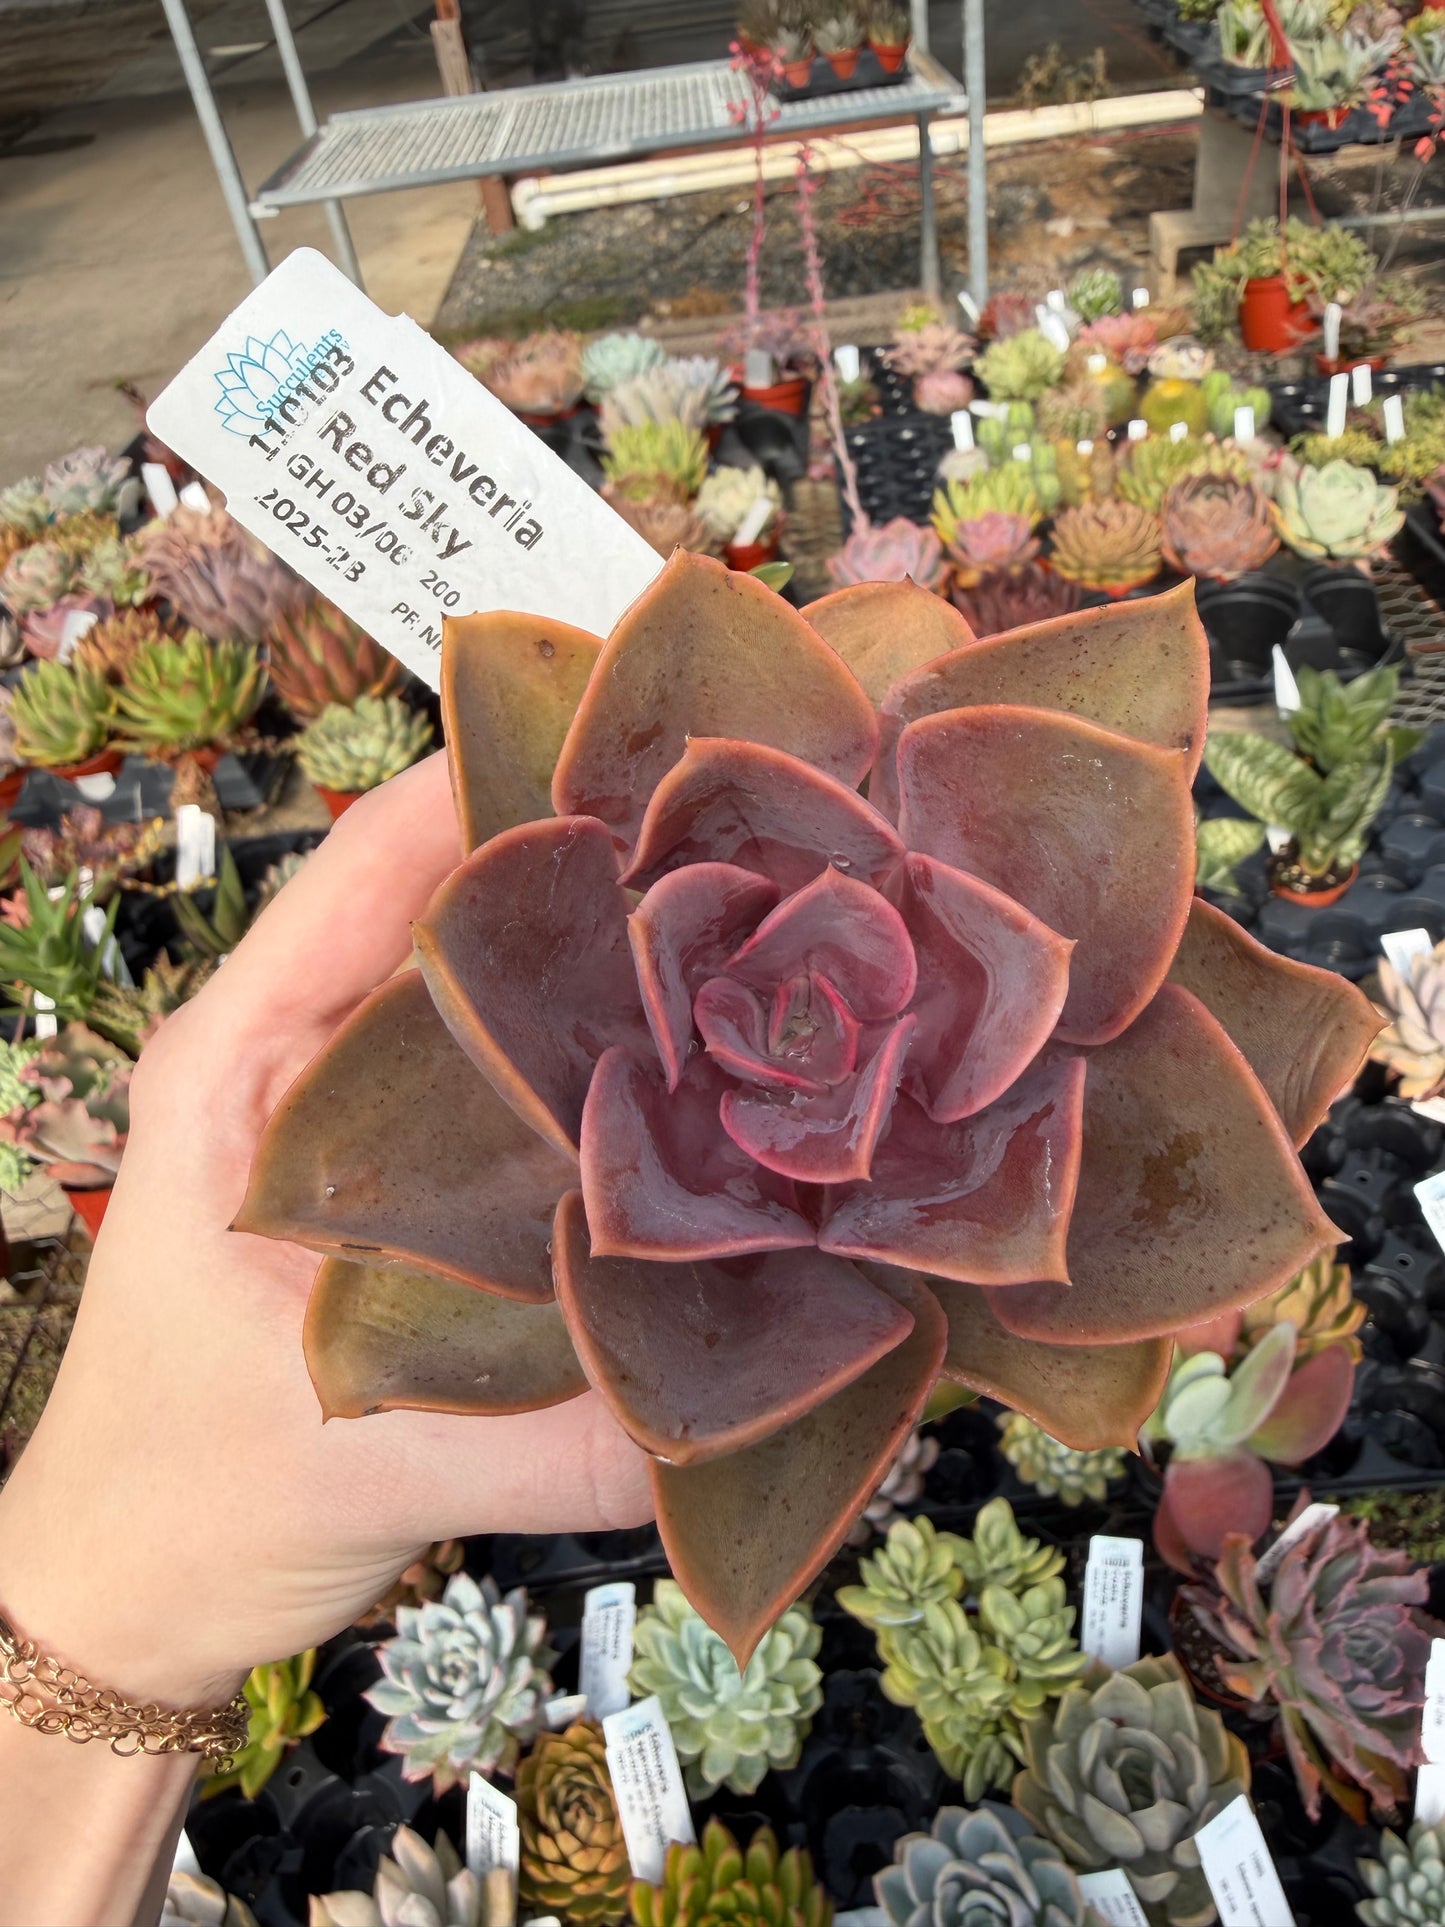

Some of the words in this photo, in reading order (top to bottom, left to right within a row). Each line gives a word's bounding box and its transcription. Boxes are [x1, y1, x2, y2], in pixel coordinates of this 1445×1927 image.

[286, 453, 336, 500] GH
[317, 410, 407, 495] Red
[398, 486, 473, 560] Sky
[359, 365, 545, 551] Echeveria
[419, 569, 461, 607] 200
